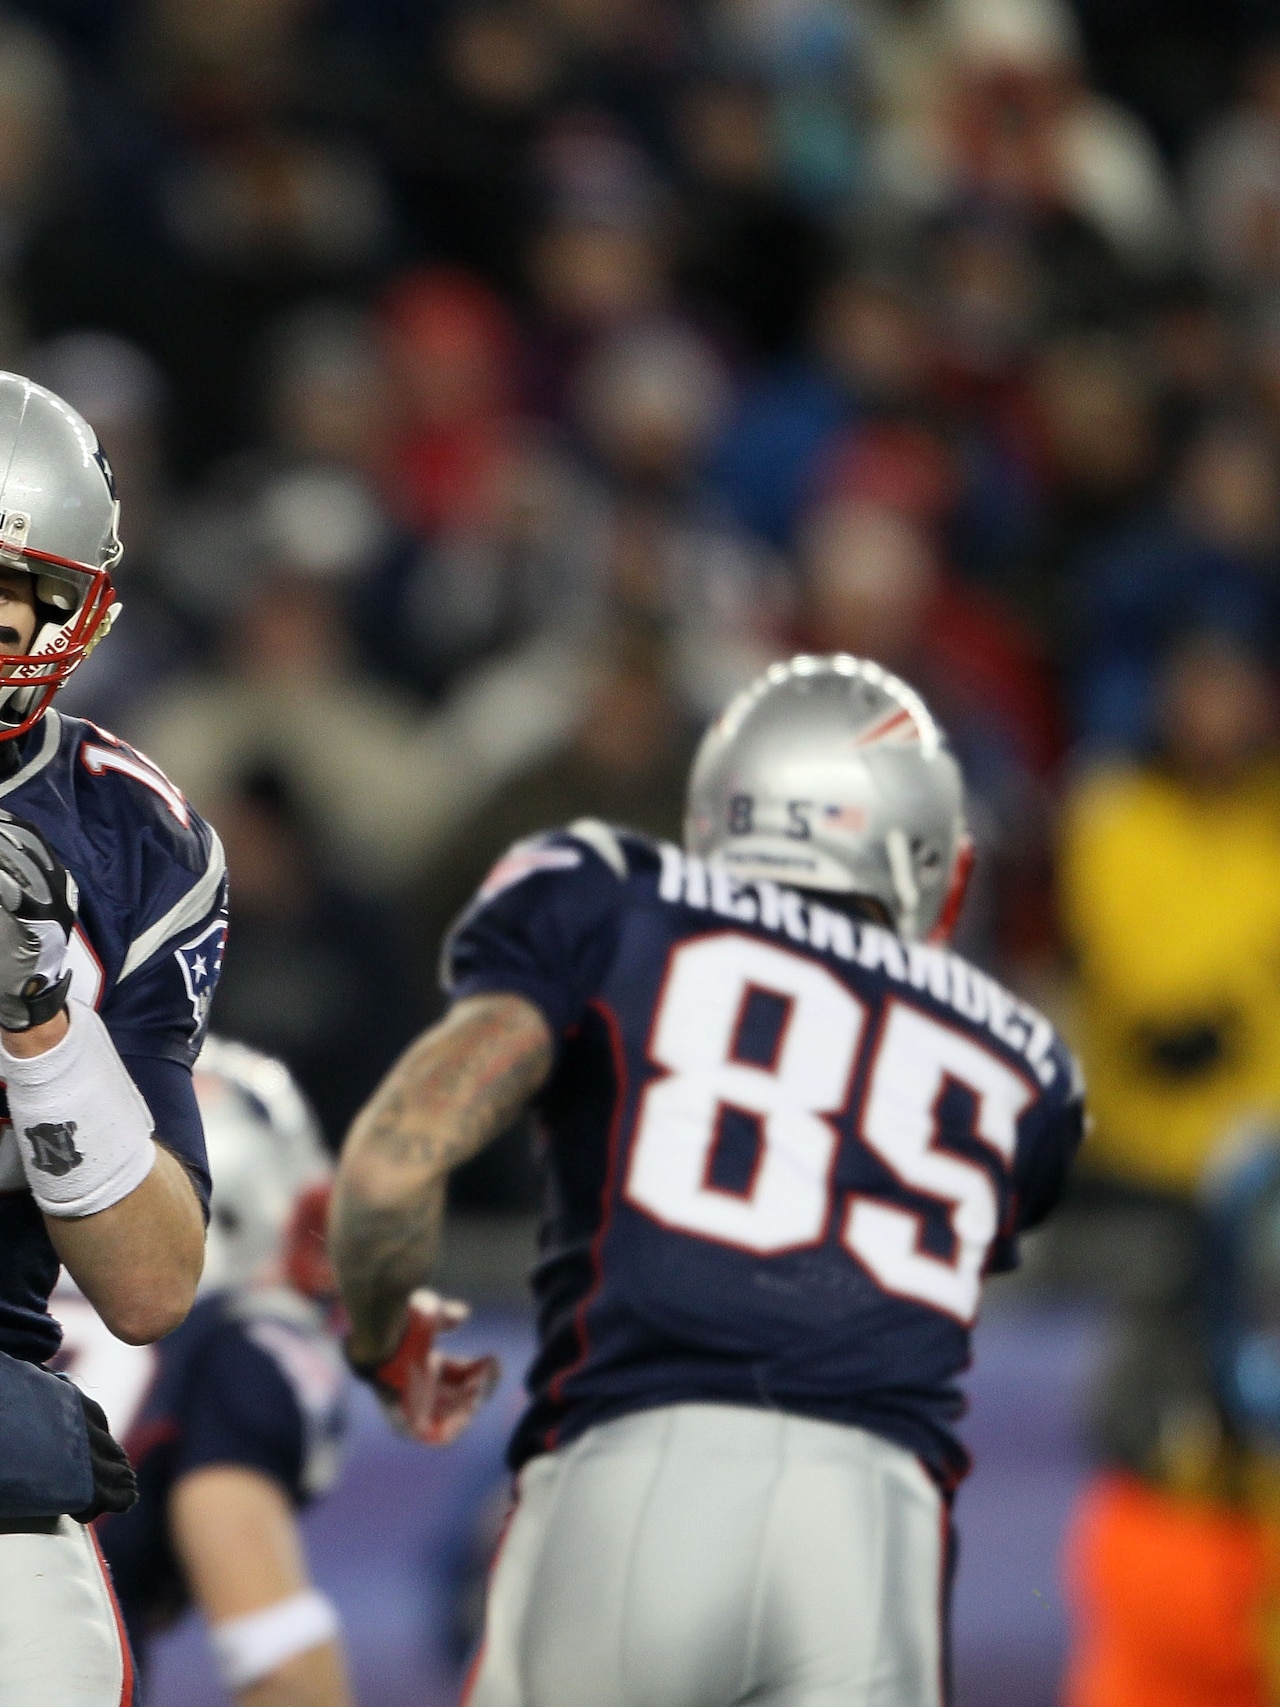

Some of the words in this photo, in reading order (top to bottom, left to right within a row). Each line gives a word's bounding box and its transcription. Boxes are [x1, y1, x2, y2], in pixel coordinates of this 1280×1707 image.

[19, 626, 74, 677] Rdell
[656, 844, 1057, 1087] HERNANDEZ
[622, 927, 1039, 1326] 85
